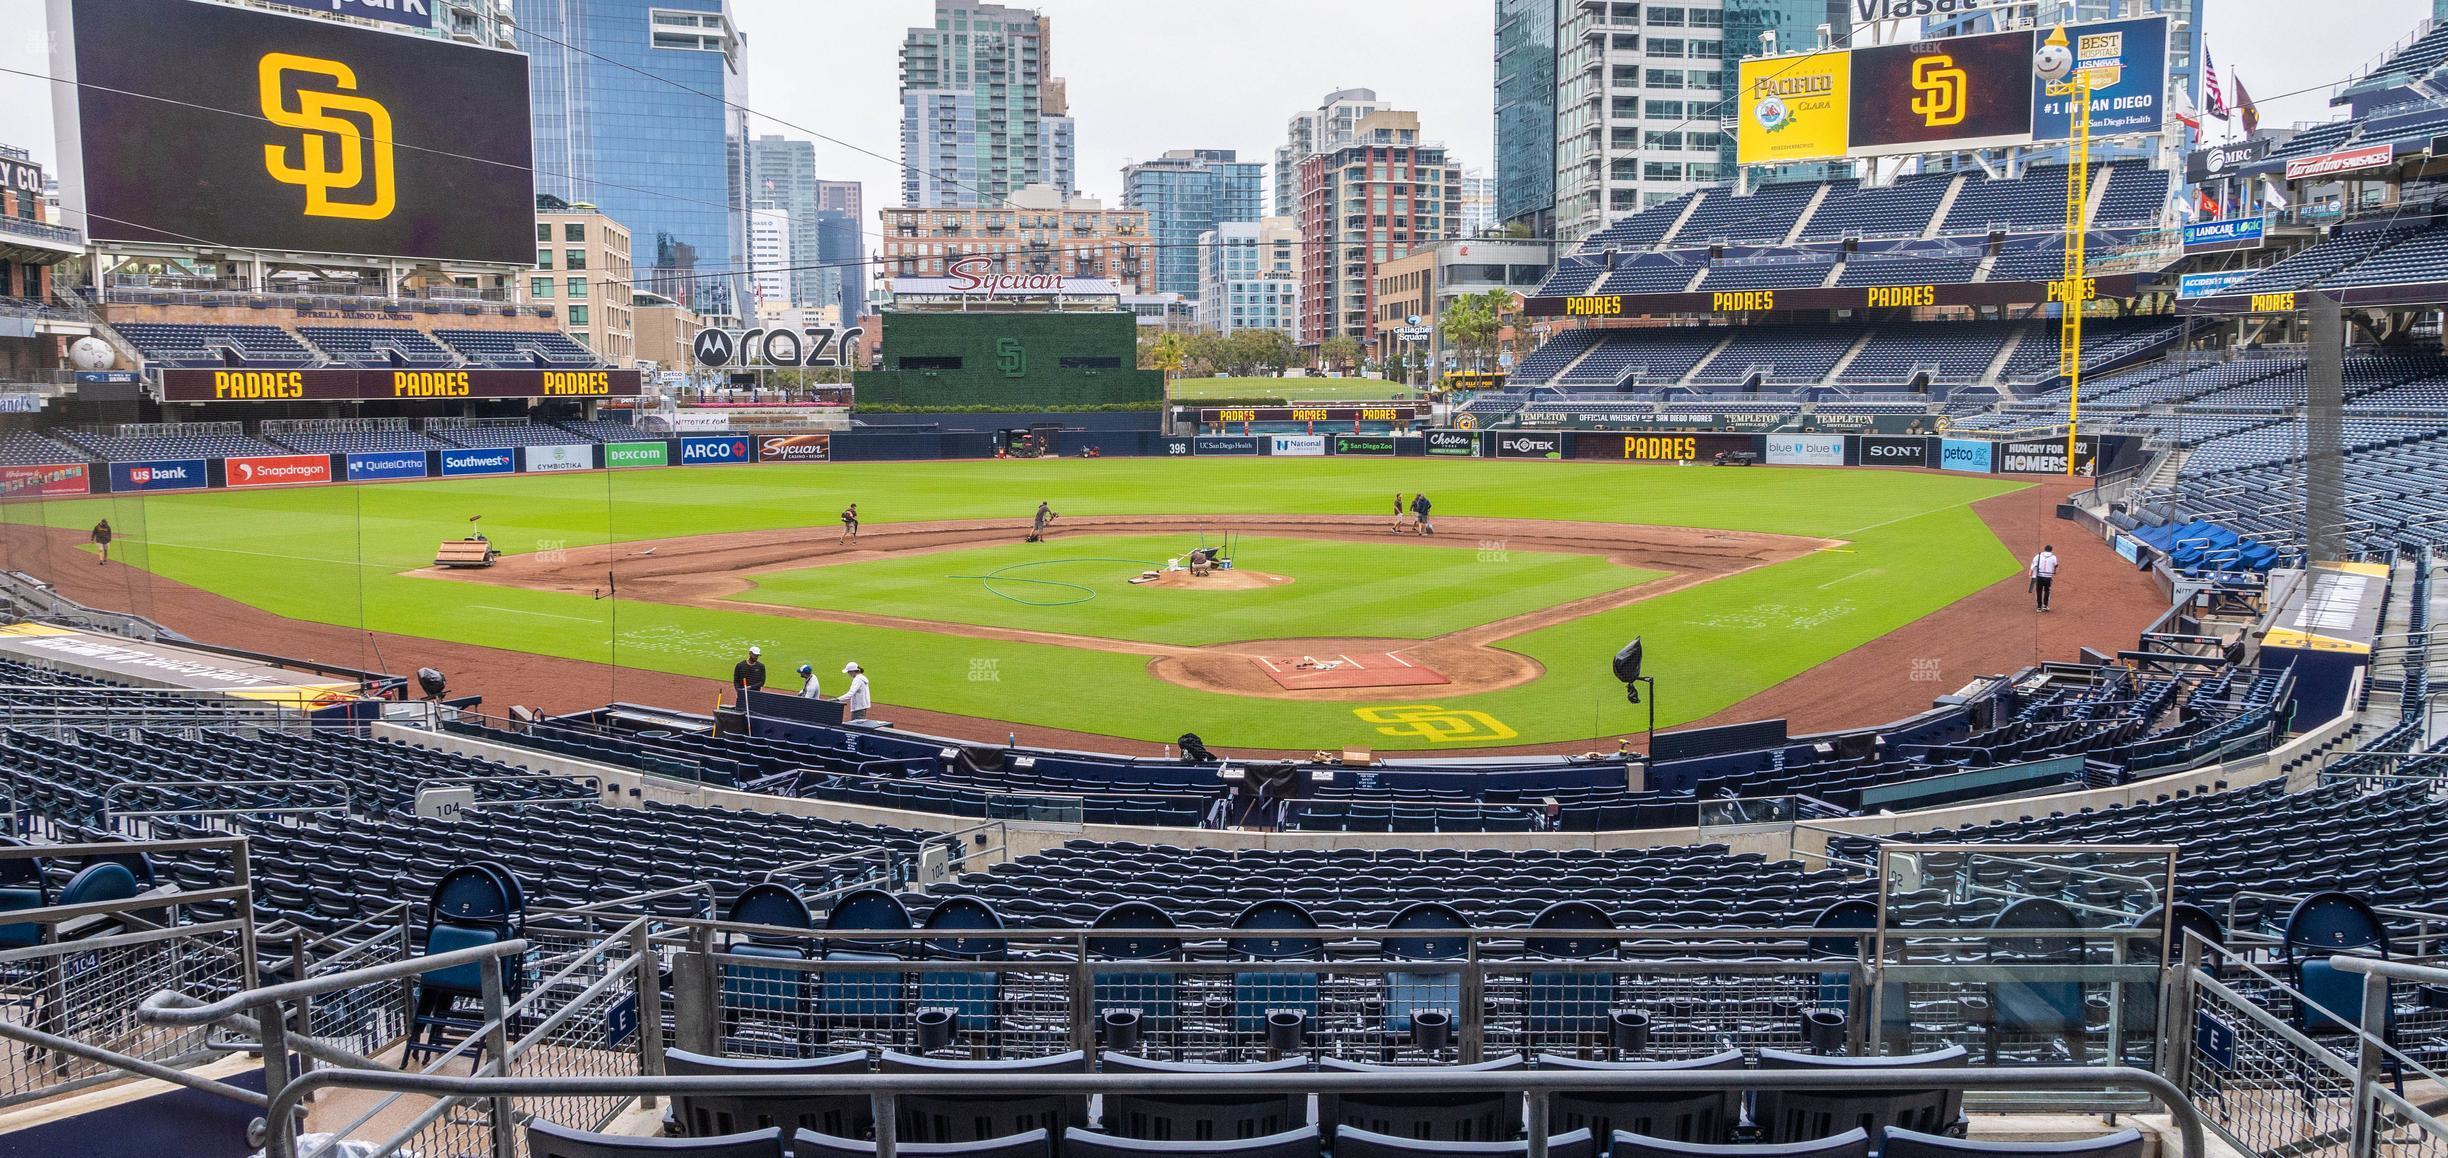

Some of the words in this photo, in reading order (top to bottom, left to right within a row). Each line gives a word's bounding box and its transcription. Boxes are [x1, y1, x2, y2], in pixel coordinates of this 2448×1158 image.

[2081, 35, 2119, 50] BEST
[2043, 102, 2060, 115] #1
[2113, 94, 2153, 110] DIEGO
[2104, 117, 2125, 128] Diego
[2126, 115, 2151, 125] Health
[2225, 149, 2252, 164] MRC
[2287, 157, 2343, 178] Tarantino
[2342, 152, 2389, 168] SAUSAGES
[17, 166, 42, 193] CO.
[2196, 223, 2234, 237] LANDCARE
[948, 256, 1067, 301] Sycuan
[1868, 285, 1935, 307] PADRES
[2047, 278, 2096, 302] PADES
[1567, 296, 1621, 315] PADRES
[1713, 290, 1774, 311] PADRES
[2251, 292, 2295, 312] PADRES
[296, 310, 340, 319] ESTRELLA
[1393, 326, 1434, 335] Gallagher
[1399, 333, 1428, 341] Square
[738, 327, 865, 368] razr
[214, 371, 303, 399] PADRES
[393, 371, 470, 397] PADRES
[543, 371, 609, 395] PADRES
[1363, 409, 1397, 420] PADRES
[1520, 413, 1567, 422] TEMPLETON
[1579, 414, 1609, 422] OFFICIAL
[1610, 414, 1640, 422] WHISKEY
[1656, 414, 1666, 422] SAN
[1667, 414, 1687, 422] DIEGO
[1689, 414, 1713, 422] PADRES
[1725, 414, 1780, 424] TEMPLETON
[1816, 415, 1873, 425] TEMPLETON
[1220, 442, 1234, 450] Diego
[1290, 440, 1321, 448] National
[1430, 433, 1469, 445] Chosen
[1503, 438, 1554, 453] EVOTEK
[684, 443, 730, 459] ARCO
[763, 438, 822, 460] Sycuan
[1169, 443, 1186, 455] 396
[1362, 443, 1380, 451] Diego
[1623, 436, 1696, 460] PADRES
[1769, 443, 1793, 453] blue
[1806, 444, 1830, 454] blue
[1869, 446, 1922, 457] SONY
[1944, 446, 1973, 463] petco
[2009, 443, 2044, 454] HUNGRY
[2046, 444, 2064, 454] FOR
[2075, 442, 2088, 455] 322
[366, 459, 423, 470] QuidelOrtho
[446, 455, 502, 468] Southwest
[536, 462, 582, 470] CYMBIOTIKA
[2004, 455, 2068, 472] HOMERS
[256, 465, 324, 477] Snapdragon
[436, 802, 460, 817] 104
[932, 862, 944, 880] 102
[1891, 870, 1904, 887] 02
[619, 1010, 627, 1030] E
[2210, 1029, 2219, 1050] E
